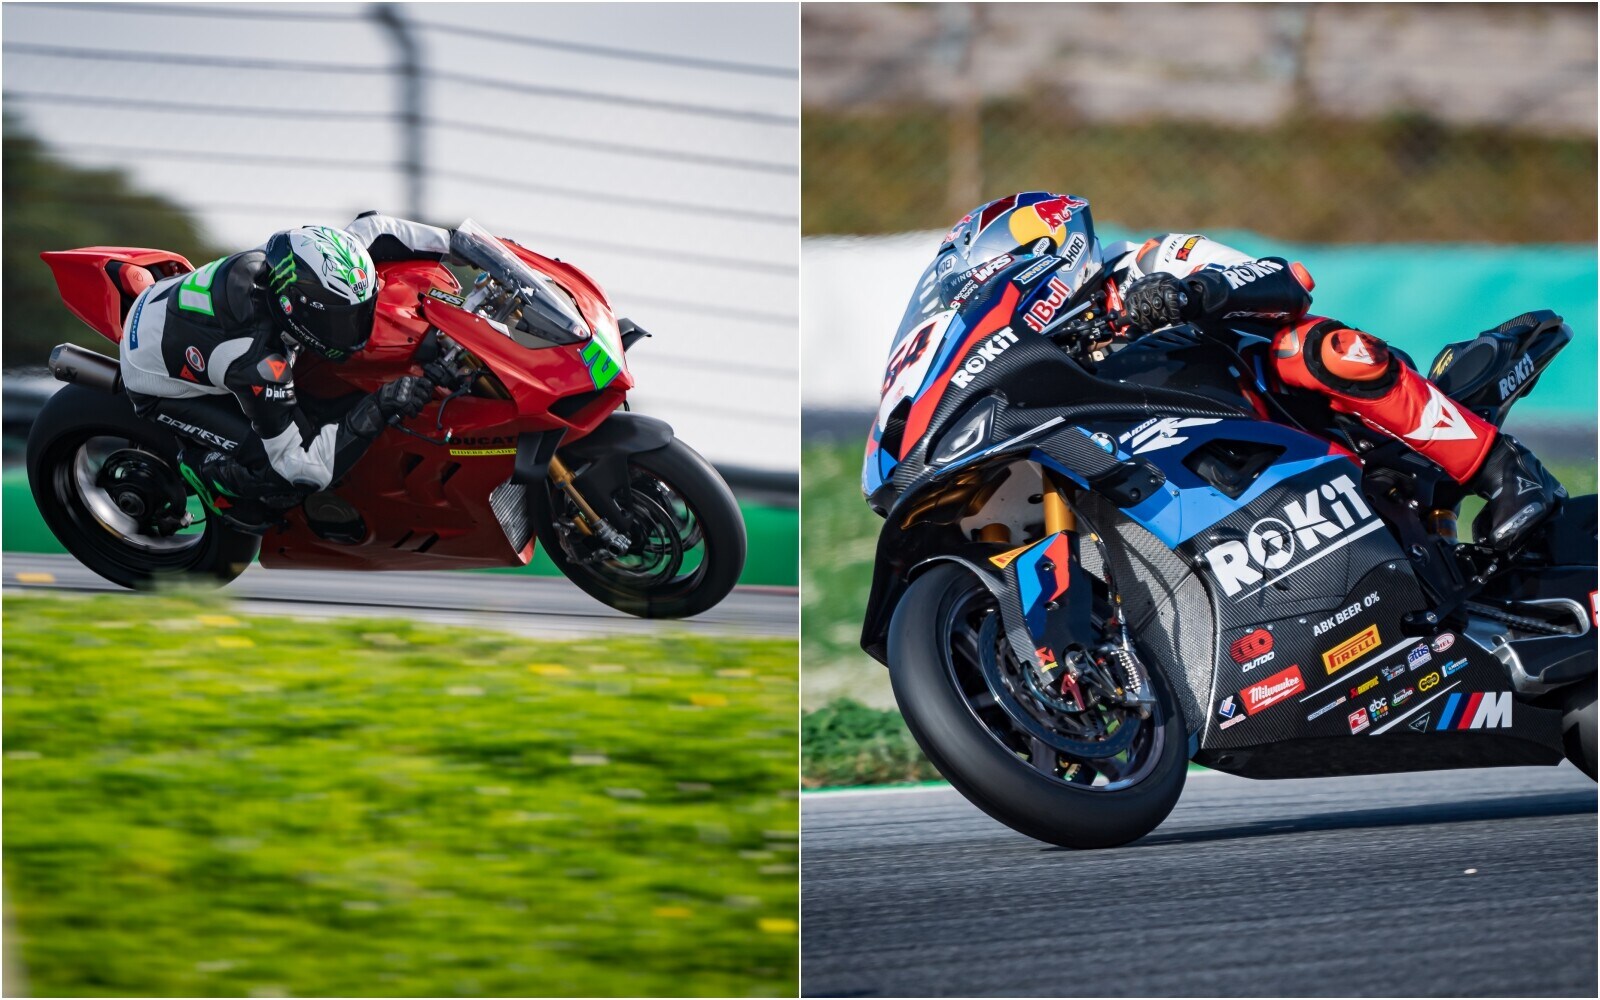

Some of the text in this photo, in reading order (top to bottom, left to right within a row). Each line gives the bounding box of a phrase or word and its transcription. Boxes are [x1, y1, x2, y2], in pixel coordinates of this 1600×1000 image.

[975, 257, 1012, 281] WRS
[429, 289, 464, 304] WRS
[1032, 277, 1071, 326] Bull
[950, 326, 1020, 389] ROKiT
[157, 413, 240, 451] DAINESE
[449, 436, 516, 445] DUCAT
[1205, 474, 1371, 597] ROKiT
[1313, 592, 1380, 637] ABK BEER 0%
[1242, 651, 1275, 673] OUTDO
[1328, 630, 1376, 668] PIRELLI
[1248, 677, 1300, 704] Milwaukee
[1370, 698, 1387, 712] ebc
